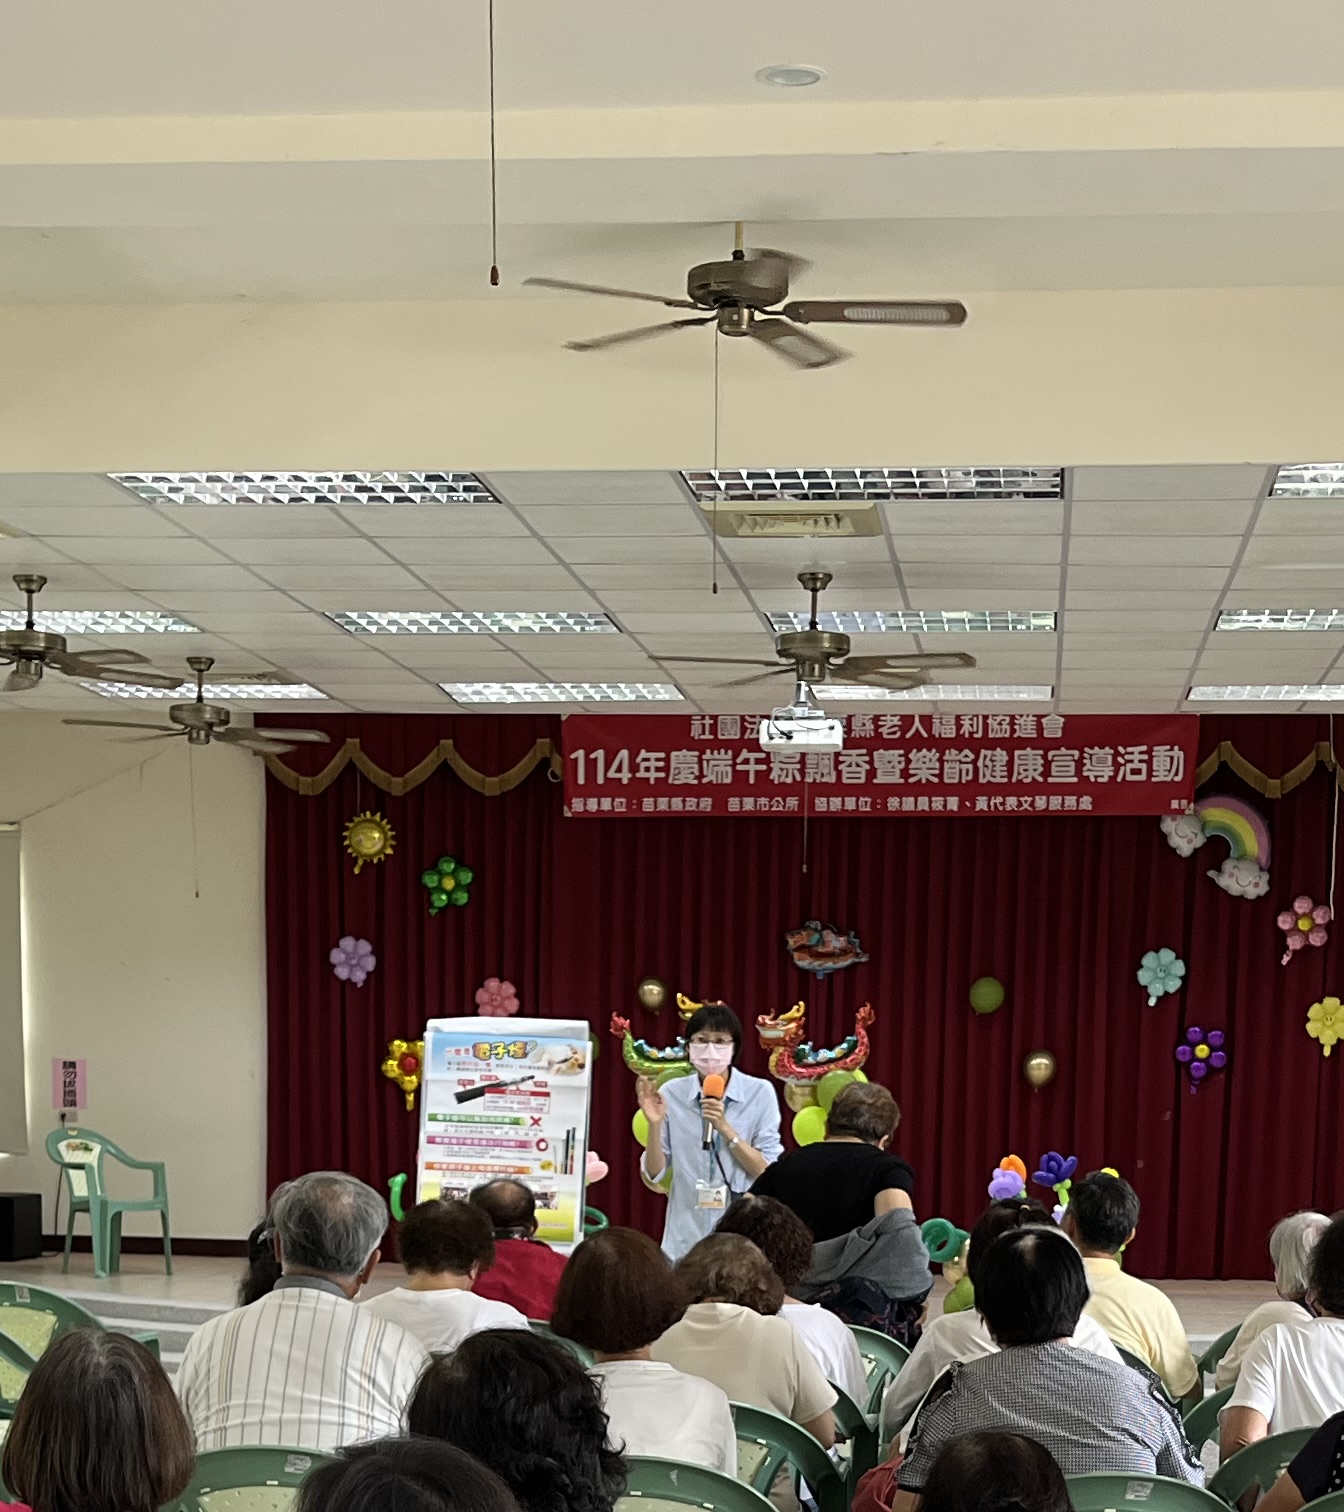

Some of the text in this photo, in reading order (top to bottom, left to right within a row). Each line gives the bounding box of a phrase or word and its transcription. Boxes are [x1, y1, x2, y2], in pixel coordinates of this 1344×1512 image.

[691, 714, 1065, 740] 社團法縣老人福利協進會
[569, 745, 1185, 785] 114年慶端午粽飄香暨樂齡健康宣導活動
